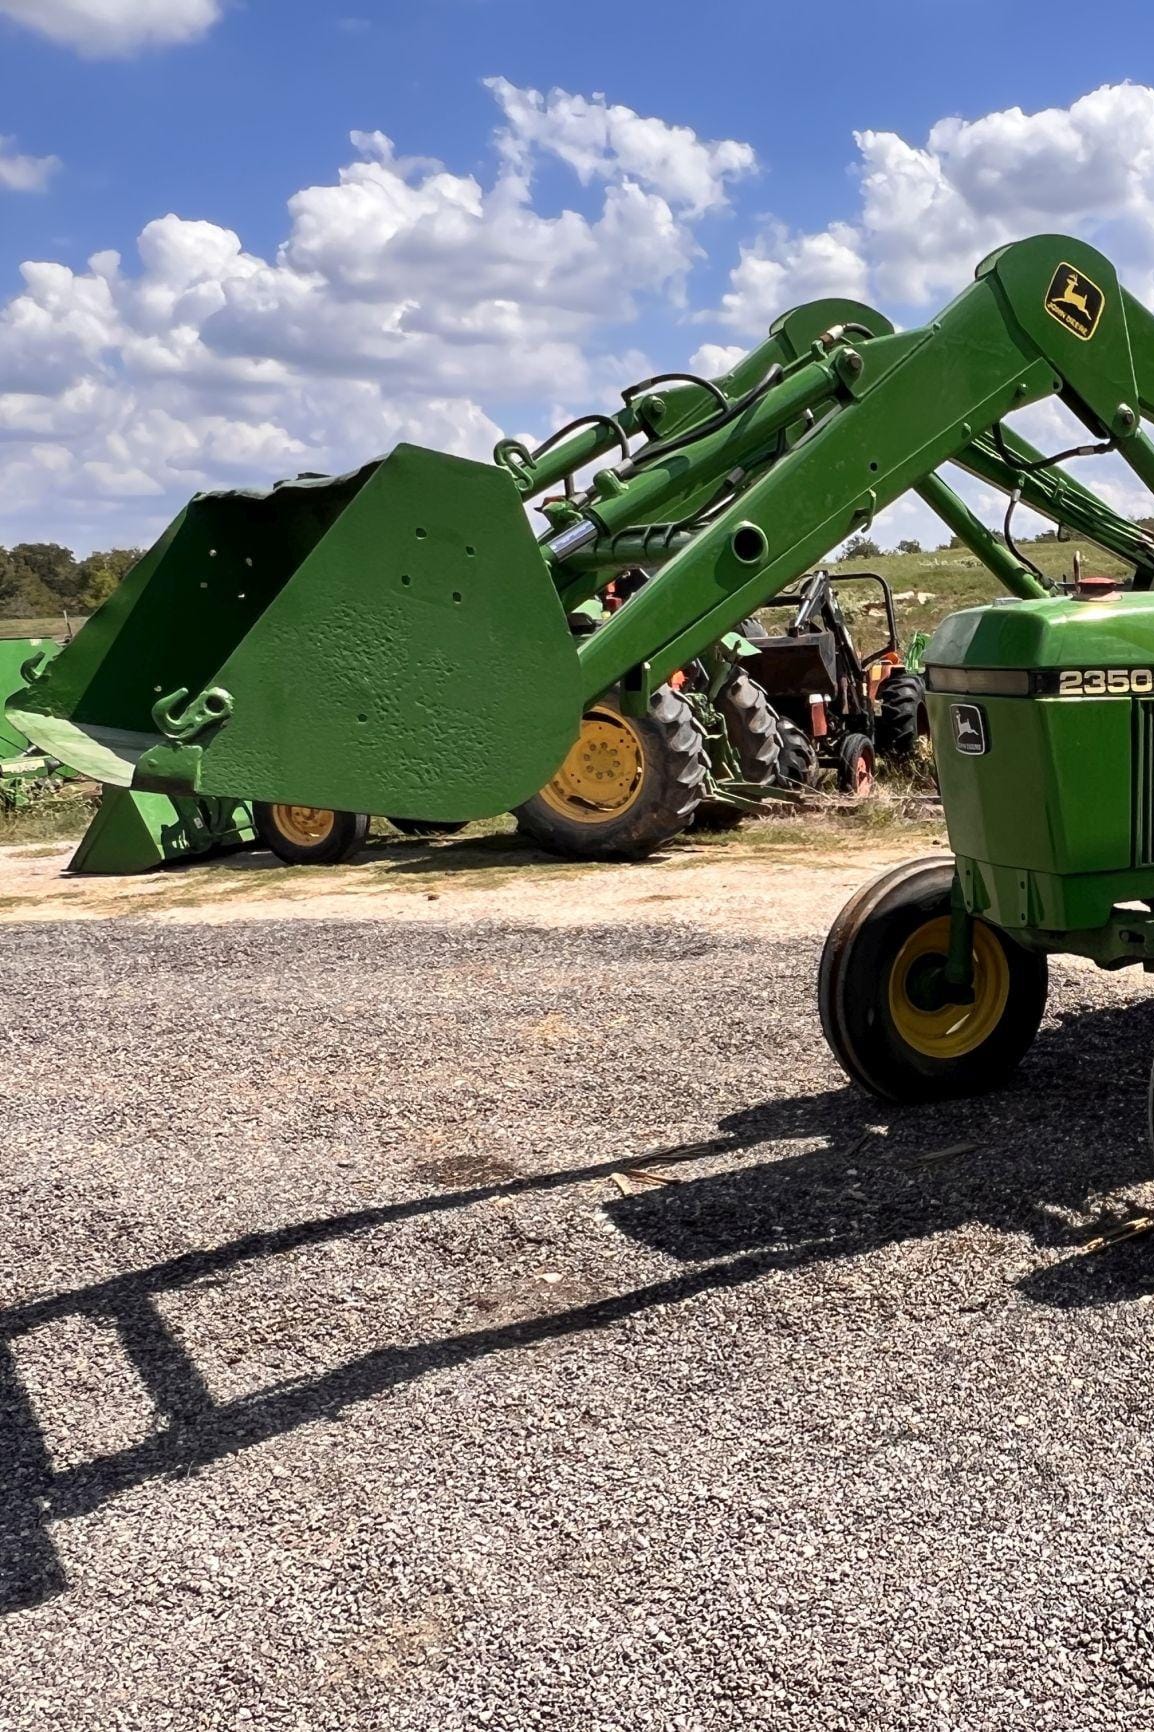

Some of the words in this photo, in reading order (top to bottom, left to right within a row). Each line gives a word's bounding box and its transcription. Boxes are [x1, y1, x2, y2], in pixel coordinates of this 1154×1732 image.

[1047, 302, 1066, 319] JOHN
[1065, 315, 1088, 336] DEERE
[1059, 669, 1153, 694] 2350
